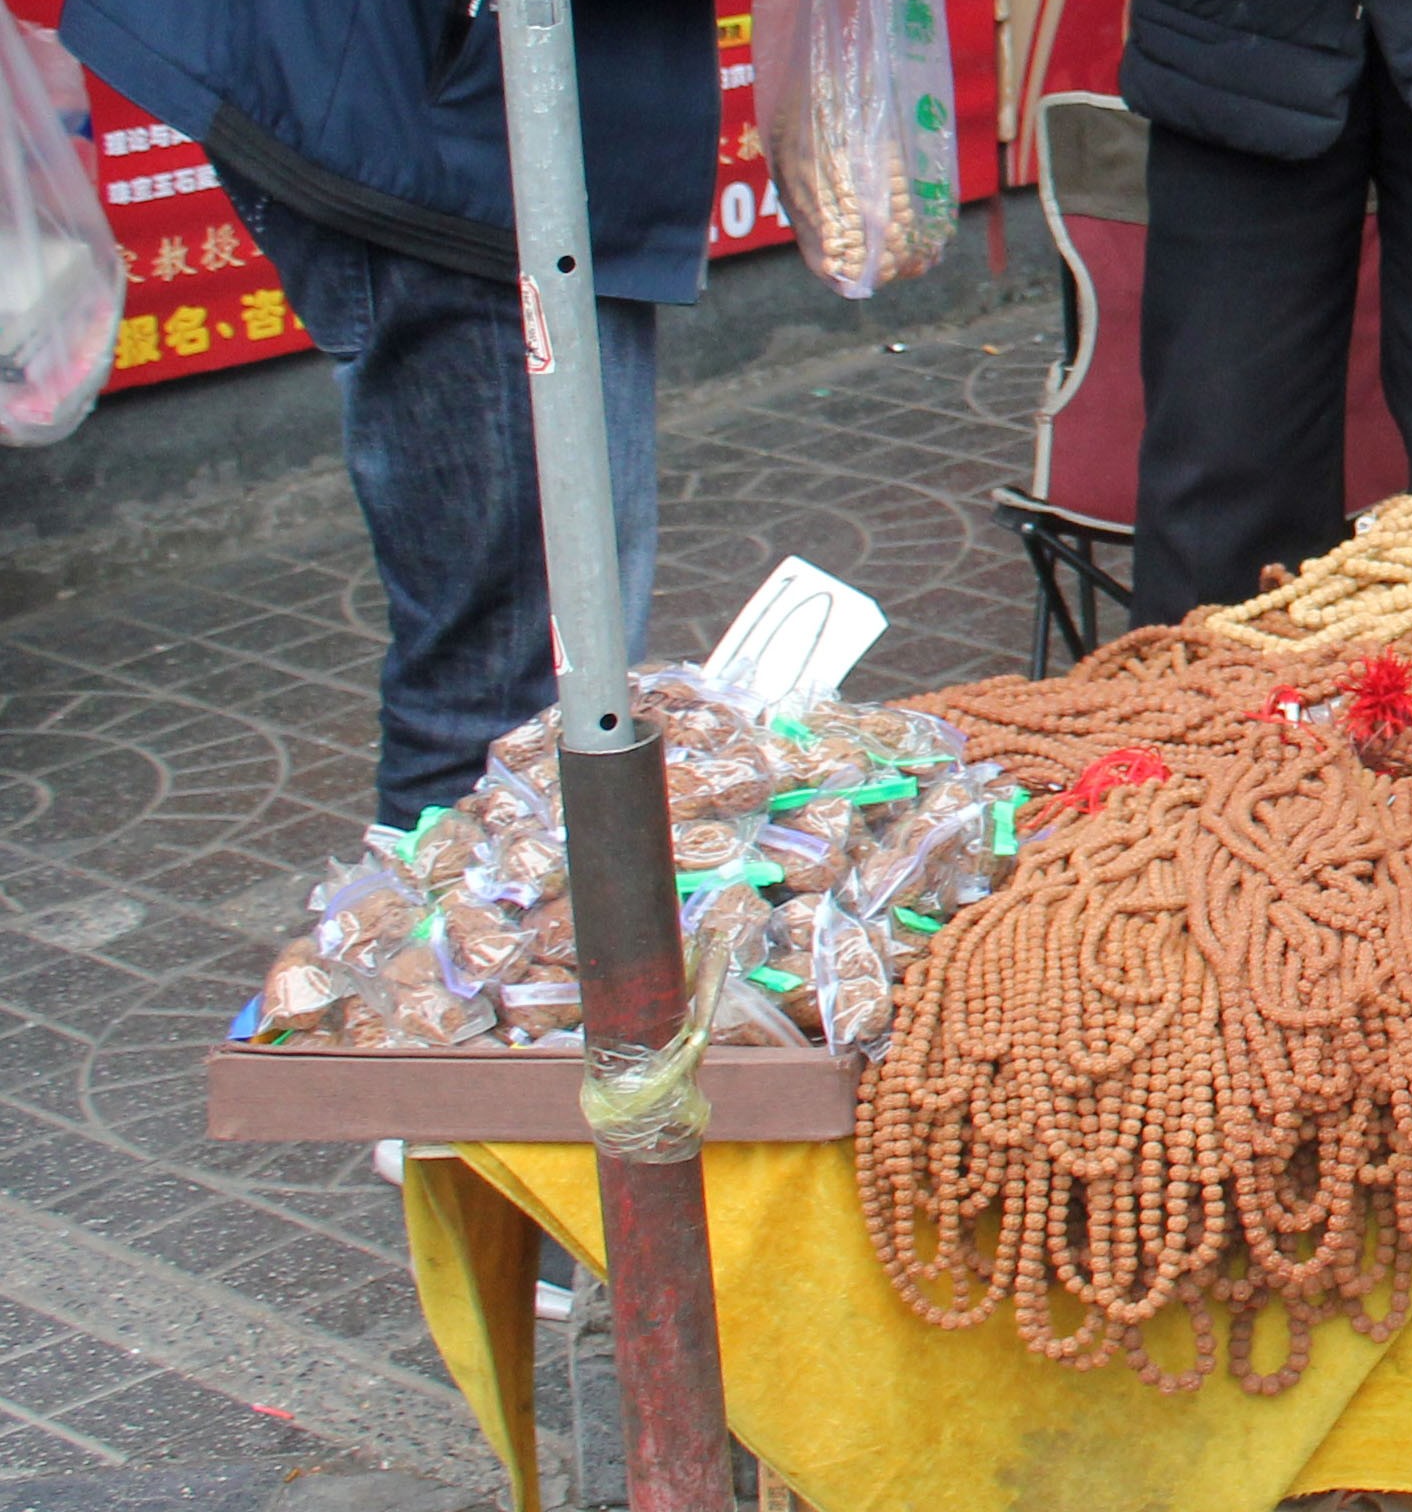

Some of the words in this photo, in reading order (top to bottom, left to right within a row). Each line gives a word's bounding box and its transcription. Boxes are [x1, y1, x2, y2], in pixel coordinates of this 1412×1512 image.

[103, 123, 194, 157] 理论与
[113, 289, 303, 370] 报名、咨
